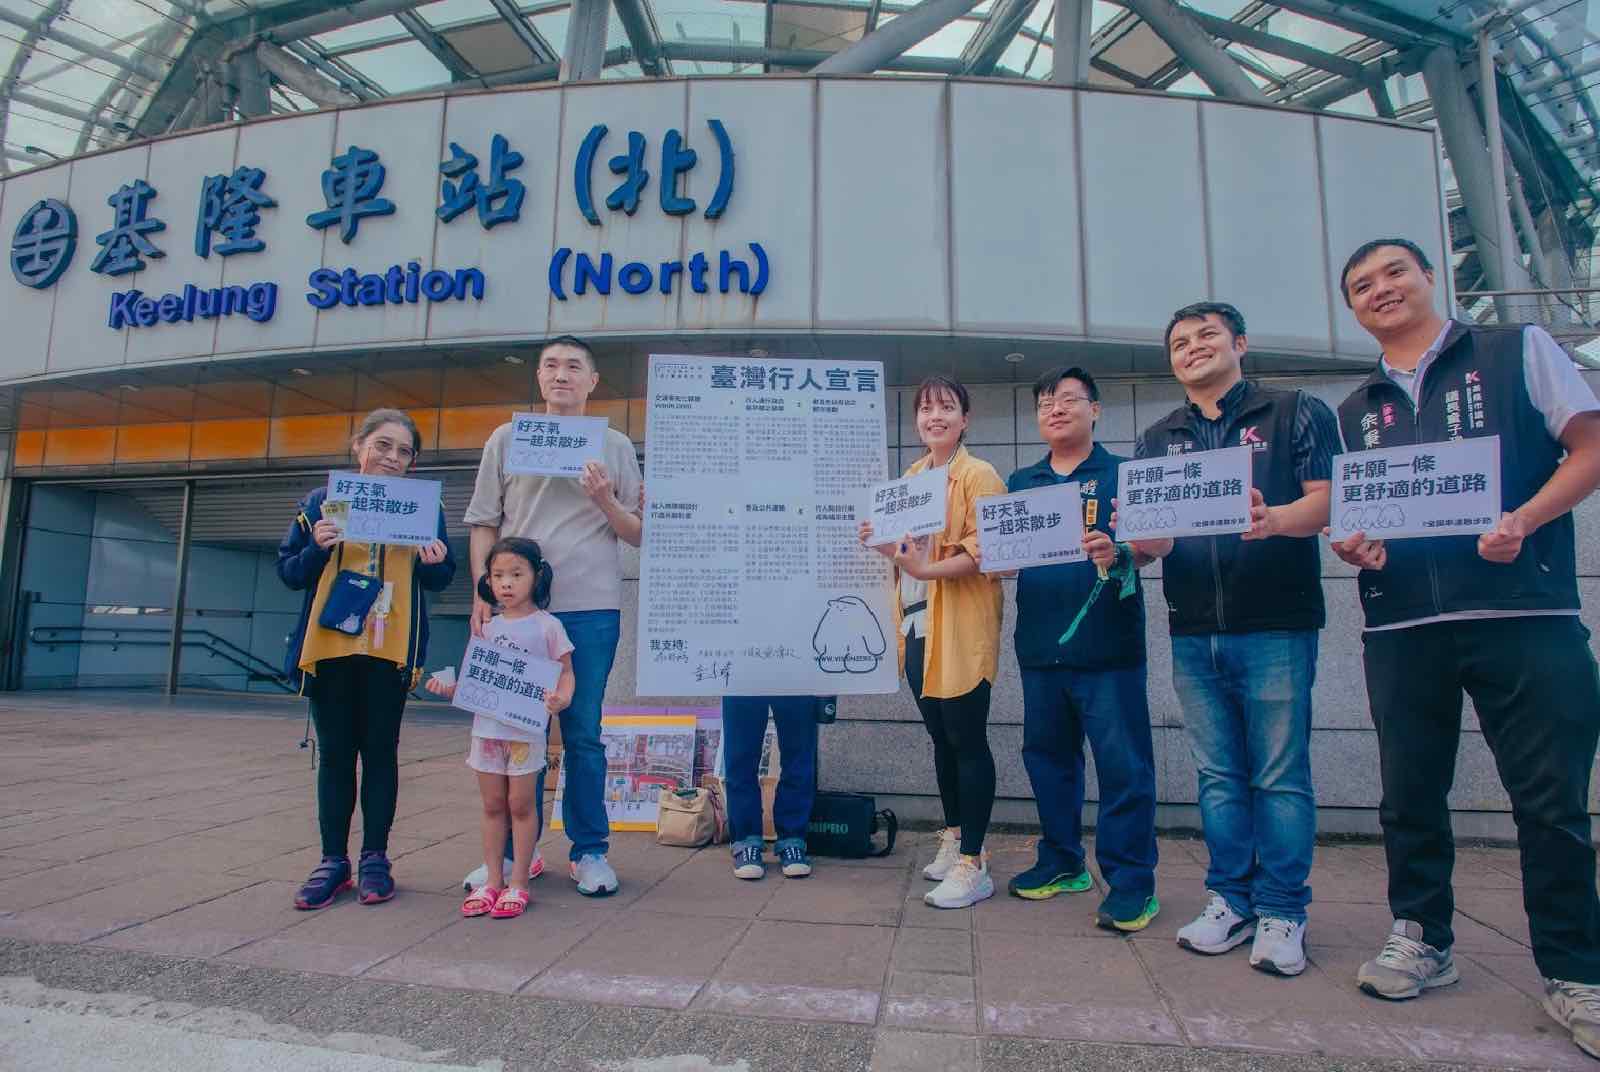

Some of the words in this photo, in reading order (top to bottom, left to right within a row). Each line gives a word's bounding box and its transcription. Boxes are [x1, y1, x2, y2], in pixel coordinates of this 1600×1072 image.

[108, 281, 278, 330] Keelung
[306, 263, 485, 309] Station
[549, 243, 770, 301] (North)
[711, 365, 879, 392] 臺灣行人宣言
[518, 420, 560, 434] 好天氣
[516, 434, 587, 448] 一起來散步
[1127, 462, 1202, 485] 許願一條
[1343, 455, 1436, 480] 許願一條
[336, 480, 387, 498] 好天氣
[875, 484, 909, 503] 好天氣
[1126, 479, 1241, 506] 更舒適的道路
[1342, 473, 1487, 502] 更舒適的道路
[343, 496, 419, 515] 一起來散步
[874, 492, 933, 515] 一起來散步
[982, 500, 1029, 520] 好天氣
[983, 513, 1061, 536] 一起來散步
[472, 646, 528, 675] 許願一條
[466, 664, 545, 702] 更舒適的道路
